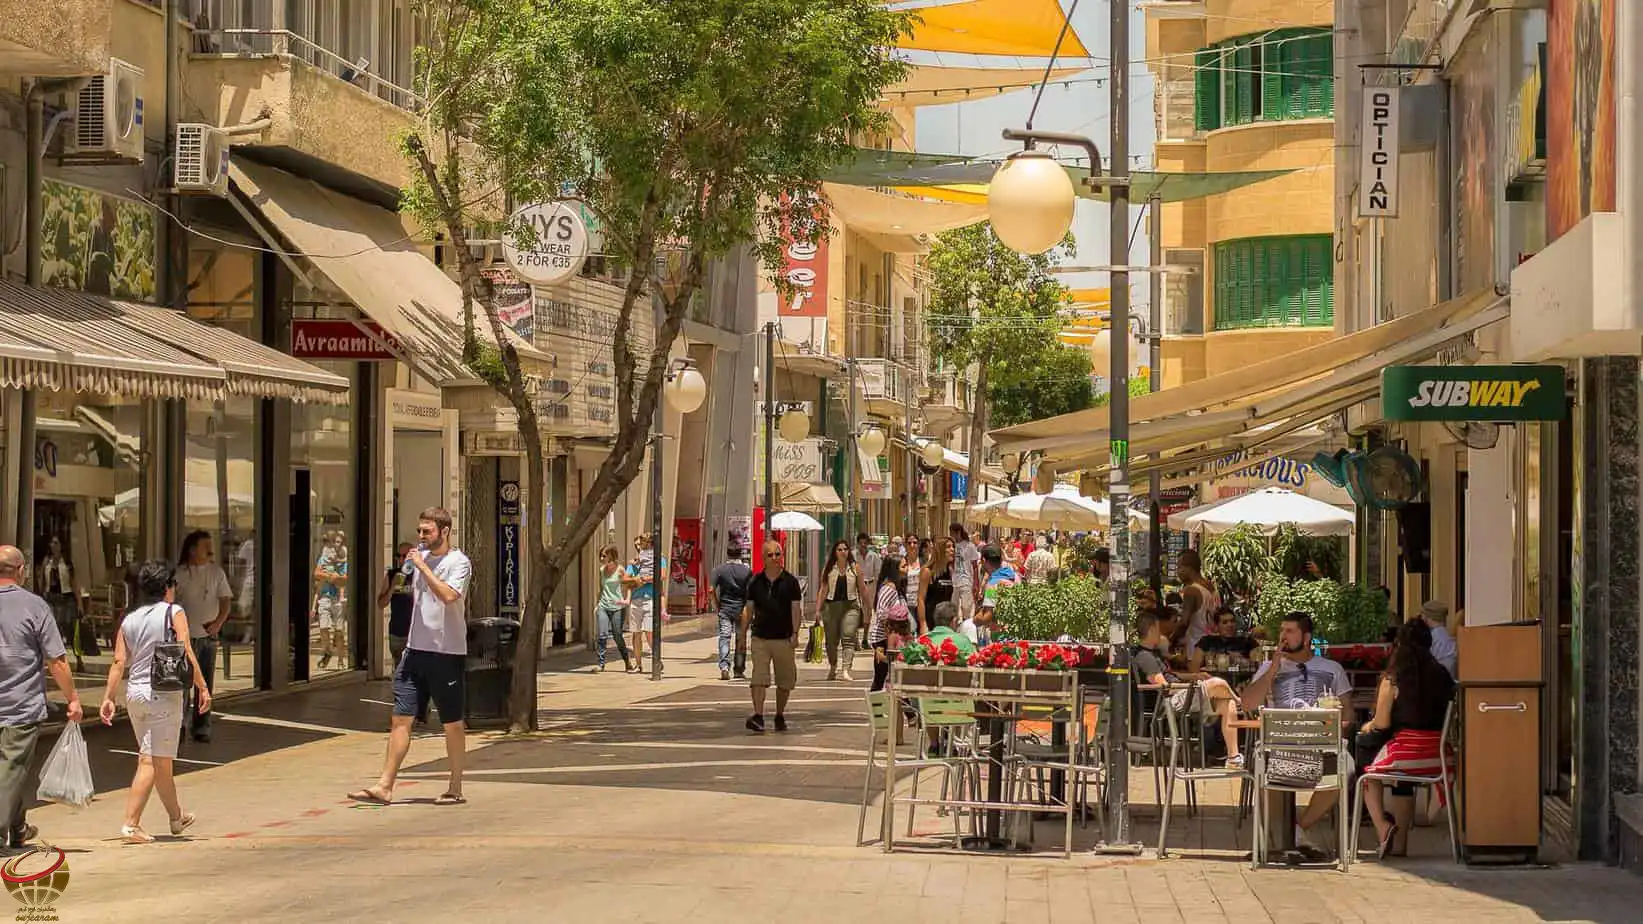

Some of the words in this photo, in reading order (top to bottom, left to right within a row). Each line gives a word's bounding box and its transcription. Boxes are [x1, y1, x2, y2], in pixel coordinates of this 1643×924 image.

[1369, 92, 1390, 210] OPTICIAN
[540, 243, 571, 255] WEAR
[517, 254, 524, 266] 2
[526, 255, 549, 268] FOR
[552, 257, 570, 269] €35
[1408, 378, 1542, 408] SUBWAY
